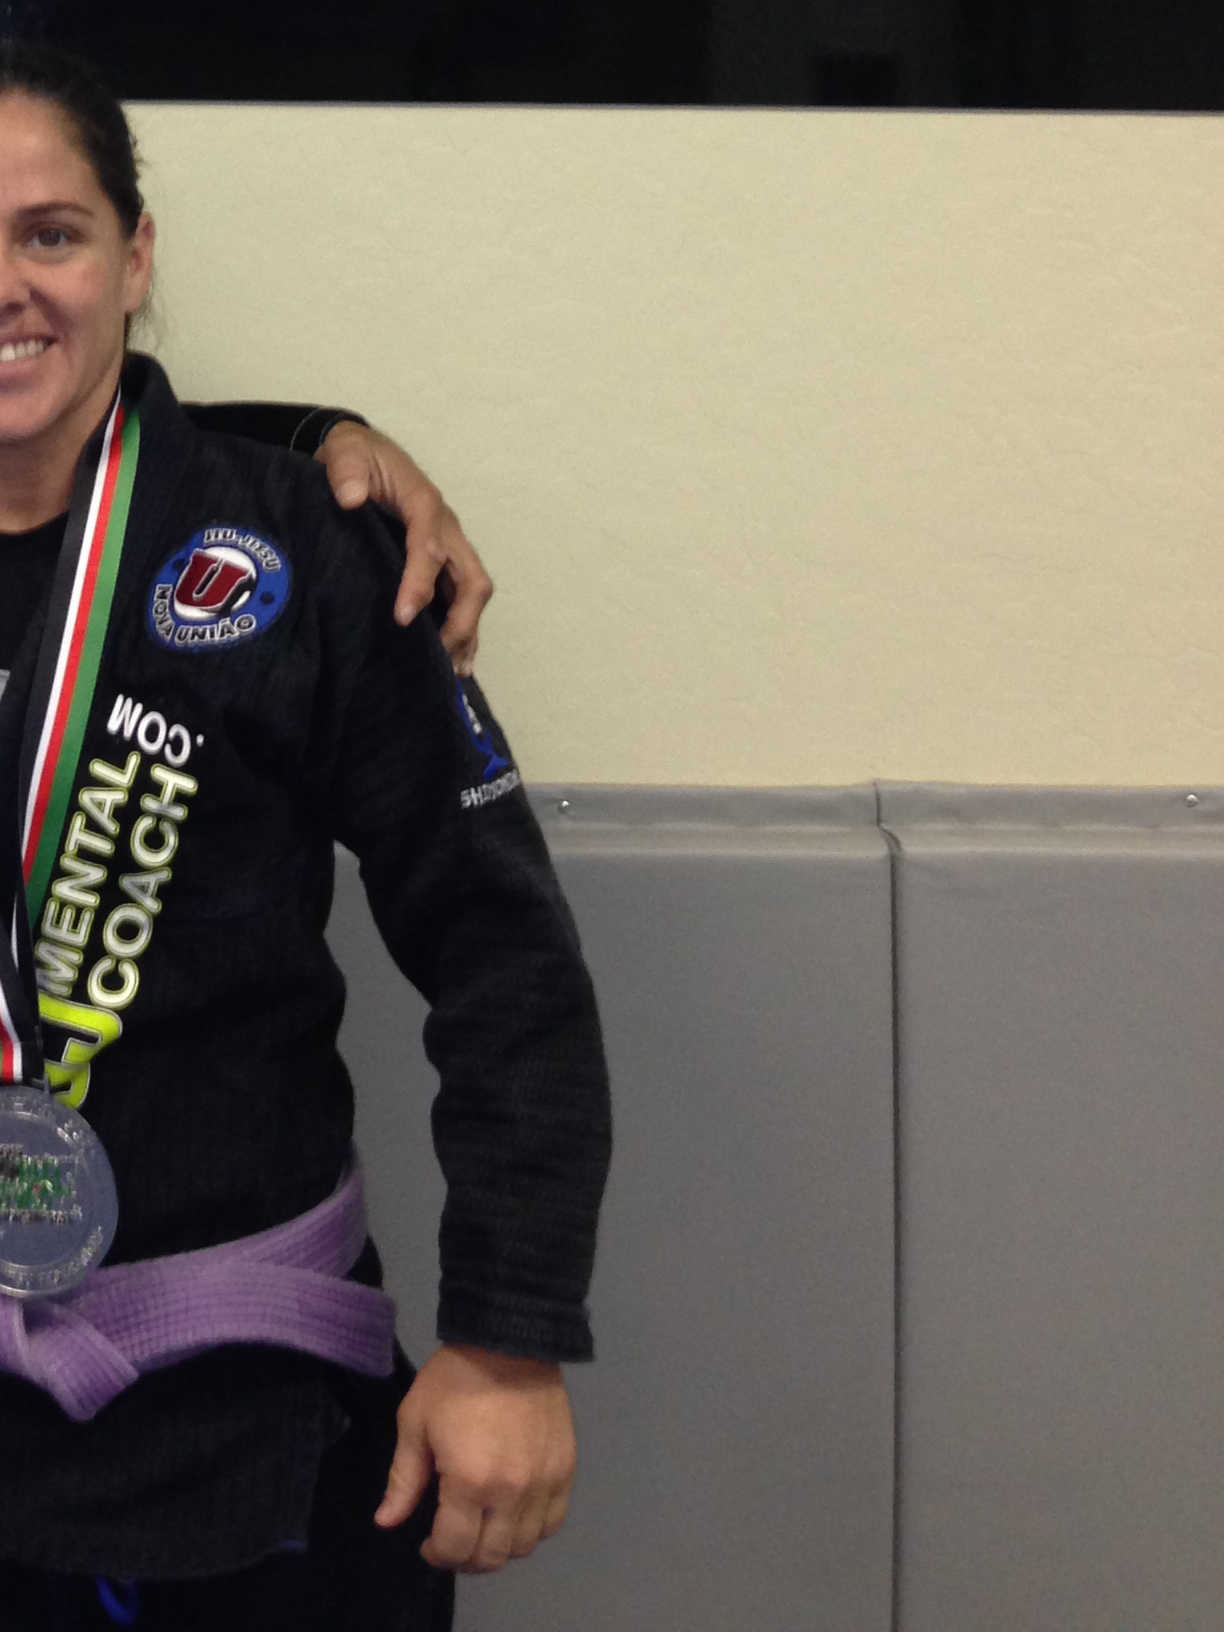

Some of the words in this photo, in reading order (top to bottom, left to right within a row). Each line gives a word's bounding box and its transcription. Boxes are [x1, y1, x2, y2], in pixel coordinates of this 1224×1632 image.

[153, 583, 176, 644] NOVA
[174, 614, 257, 646] UNIÃO
[106, 693, 205, 766] .COM
[34, 751, 141, 998] MENTAL
[87, 763, 198, 1011] COACH
